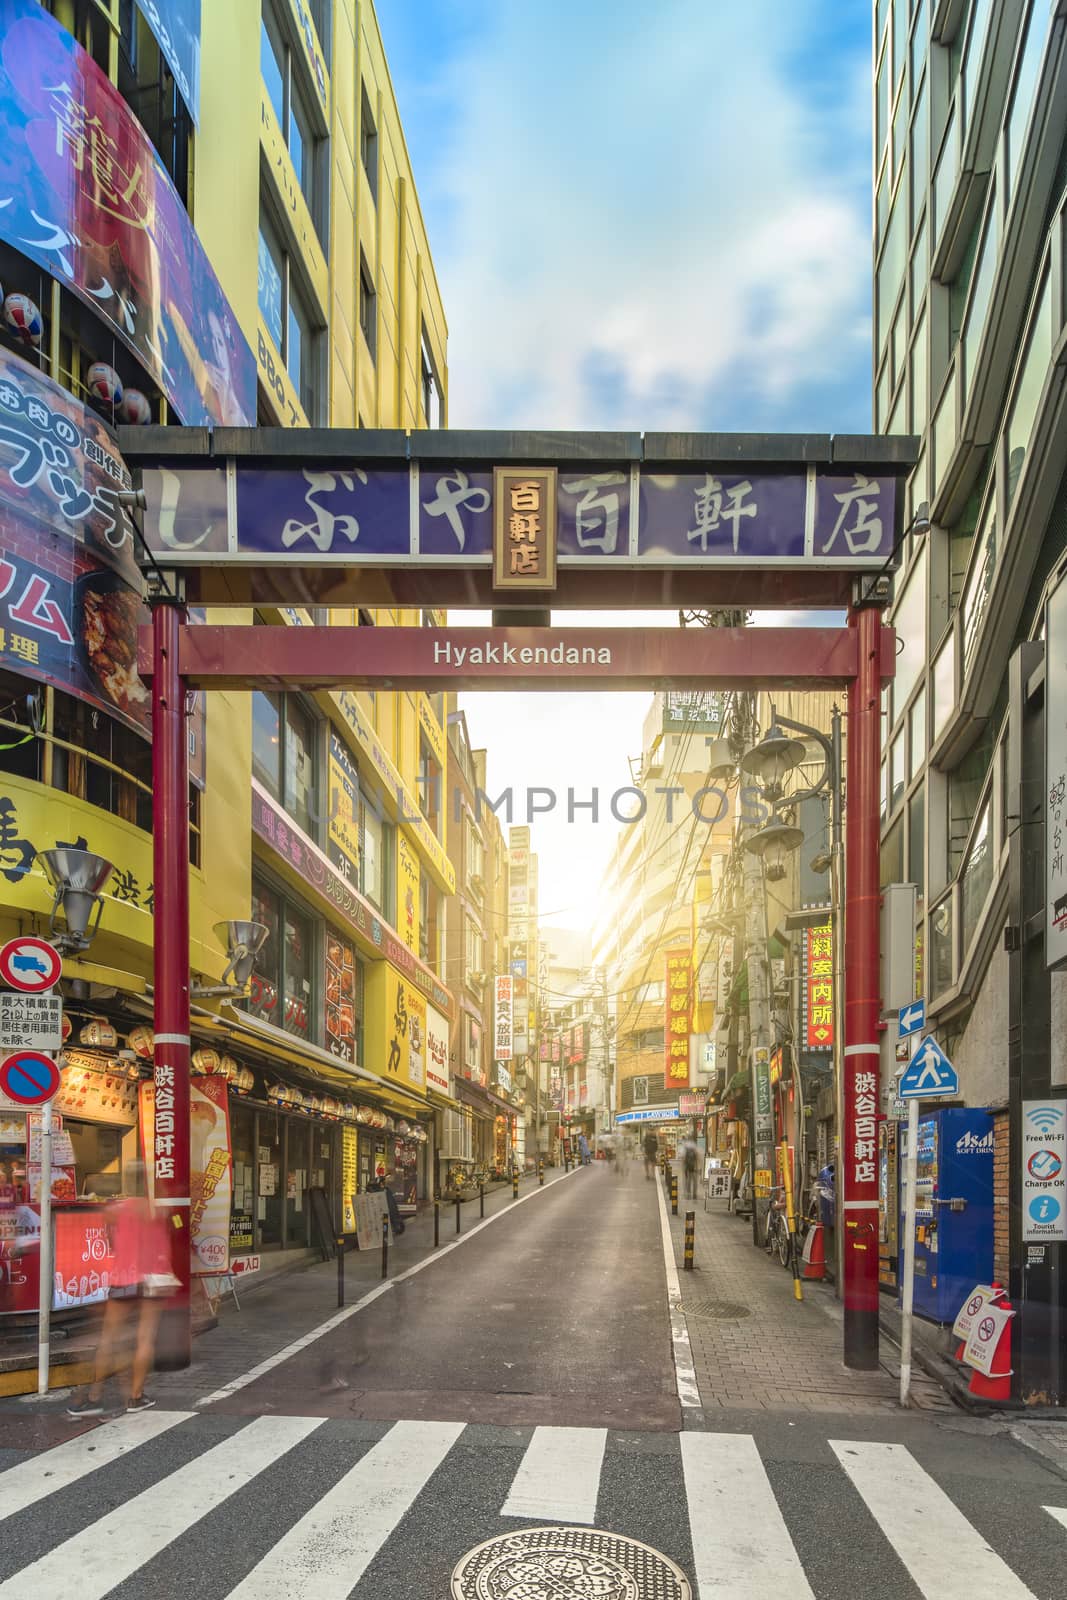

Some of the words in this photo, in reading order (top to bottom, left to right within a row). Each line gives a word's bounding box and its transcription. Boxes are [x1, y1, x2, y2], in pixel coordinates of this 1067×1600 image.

[0, 383, 75, 443] お肉の
[157, 466, 491, 552] しぶや
[561, 470, 884, 555] 百軒店
[508, 481, 541, 575] 百軒店
[0, 627, 40, 665] 理
[433, 641, 612, 668] Hyakkendana
[337, 854, 351, 879] 3F
[1, 996, 59, 1010] 最大積載量
[495, 977, 511, 1047] 焼肉食べ放題
[1, 1022, 59, 1034] 居住者用車両
[1, 1034, 33, 1046] を除く
[340, 1041, 352, 1059] 2F
[155, 1065, 175, 1179] 渋谷百軒店
[855, 1072, 876, 1183] 渋谷百軒店
[956, 1131, 994, 1148] Asah
[1026, 1134, 1043, 1142] Free
[1044, 1133, 1065, 1142] Wi-Fi
[190, 1147, 232, 1238] 韓国ホットドッ
[1025, 1180, 1052, 1189] Charge
[1054, 1179, 1066, 1187] OK
[245, 1257, 259, 1271] 入口
